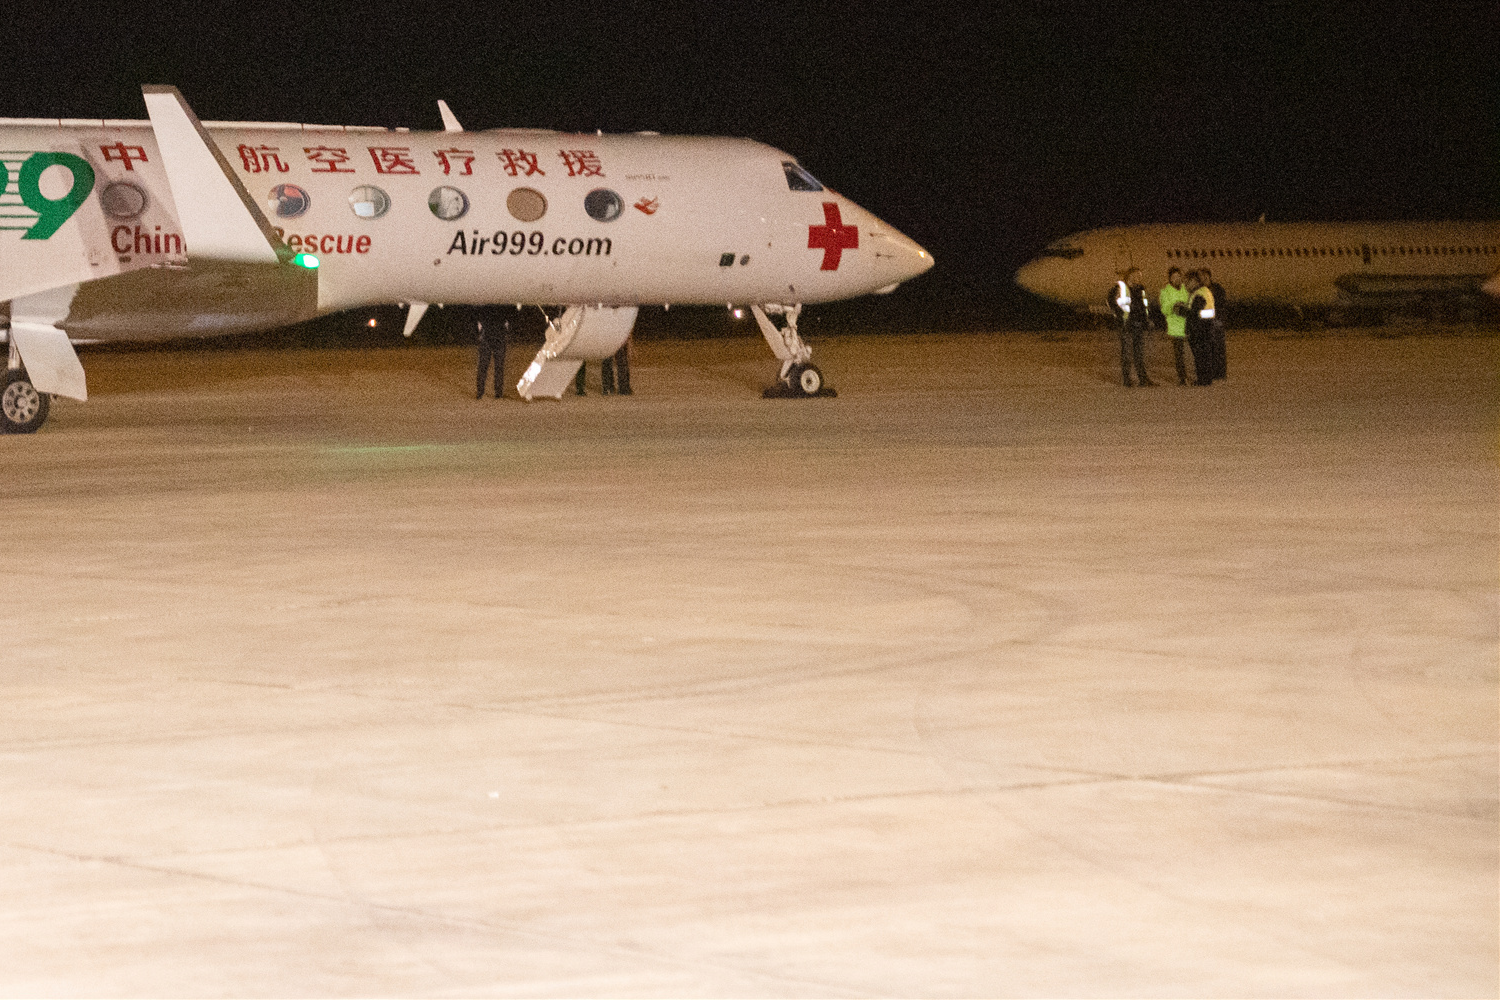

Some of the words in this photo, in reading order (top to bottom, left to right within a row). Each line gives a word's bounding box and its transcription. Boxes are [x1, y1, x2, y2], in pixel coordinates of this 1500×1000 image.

[100, 141, 605, 177] 中航空医疗救援
[111, 224, 188, 254] Chin
[447, 229, 612, 256] Air999.com
